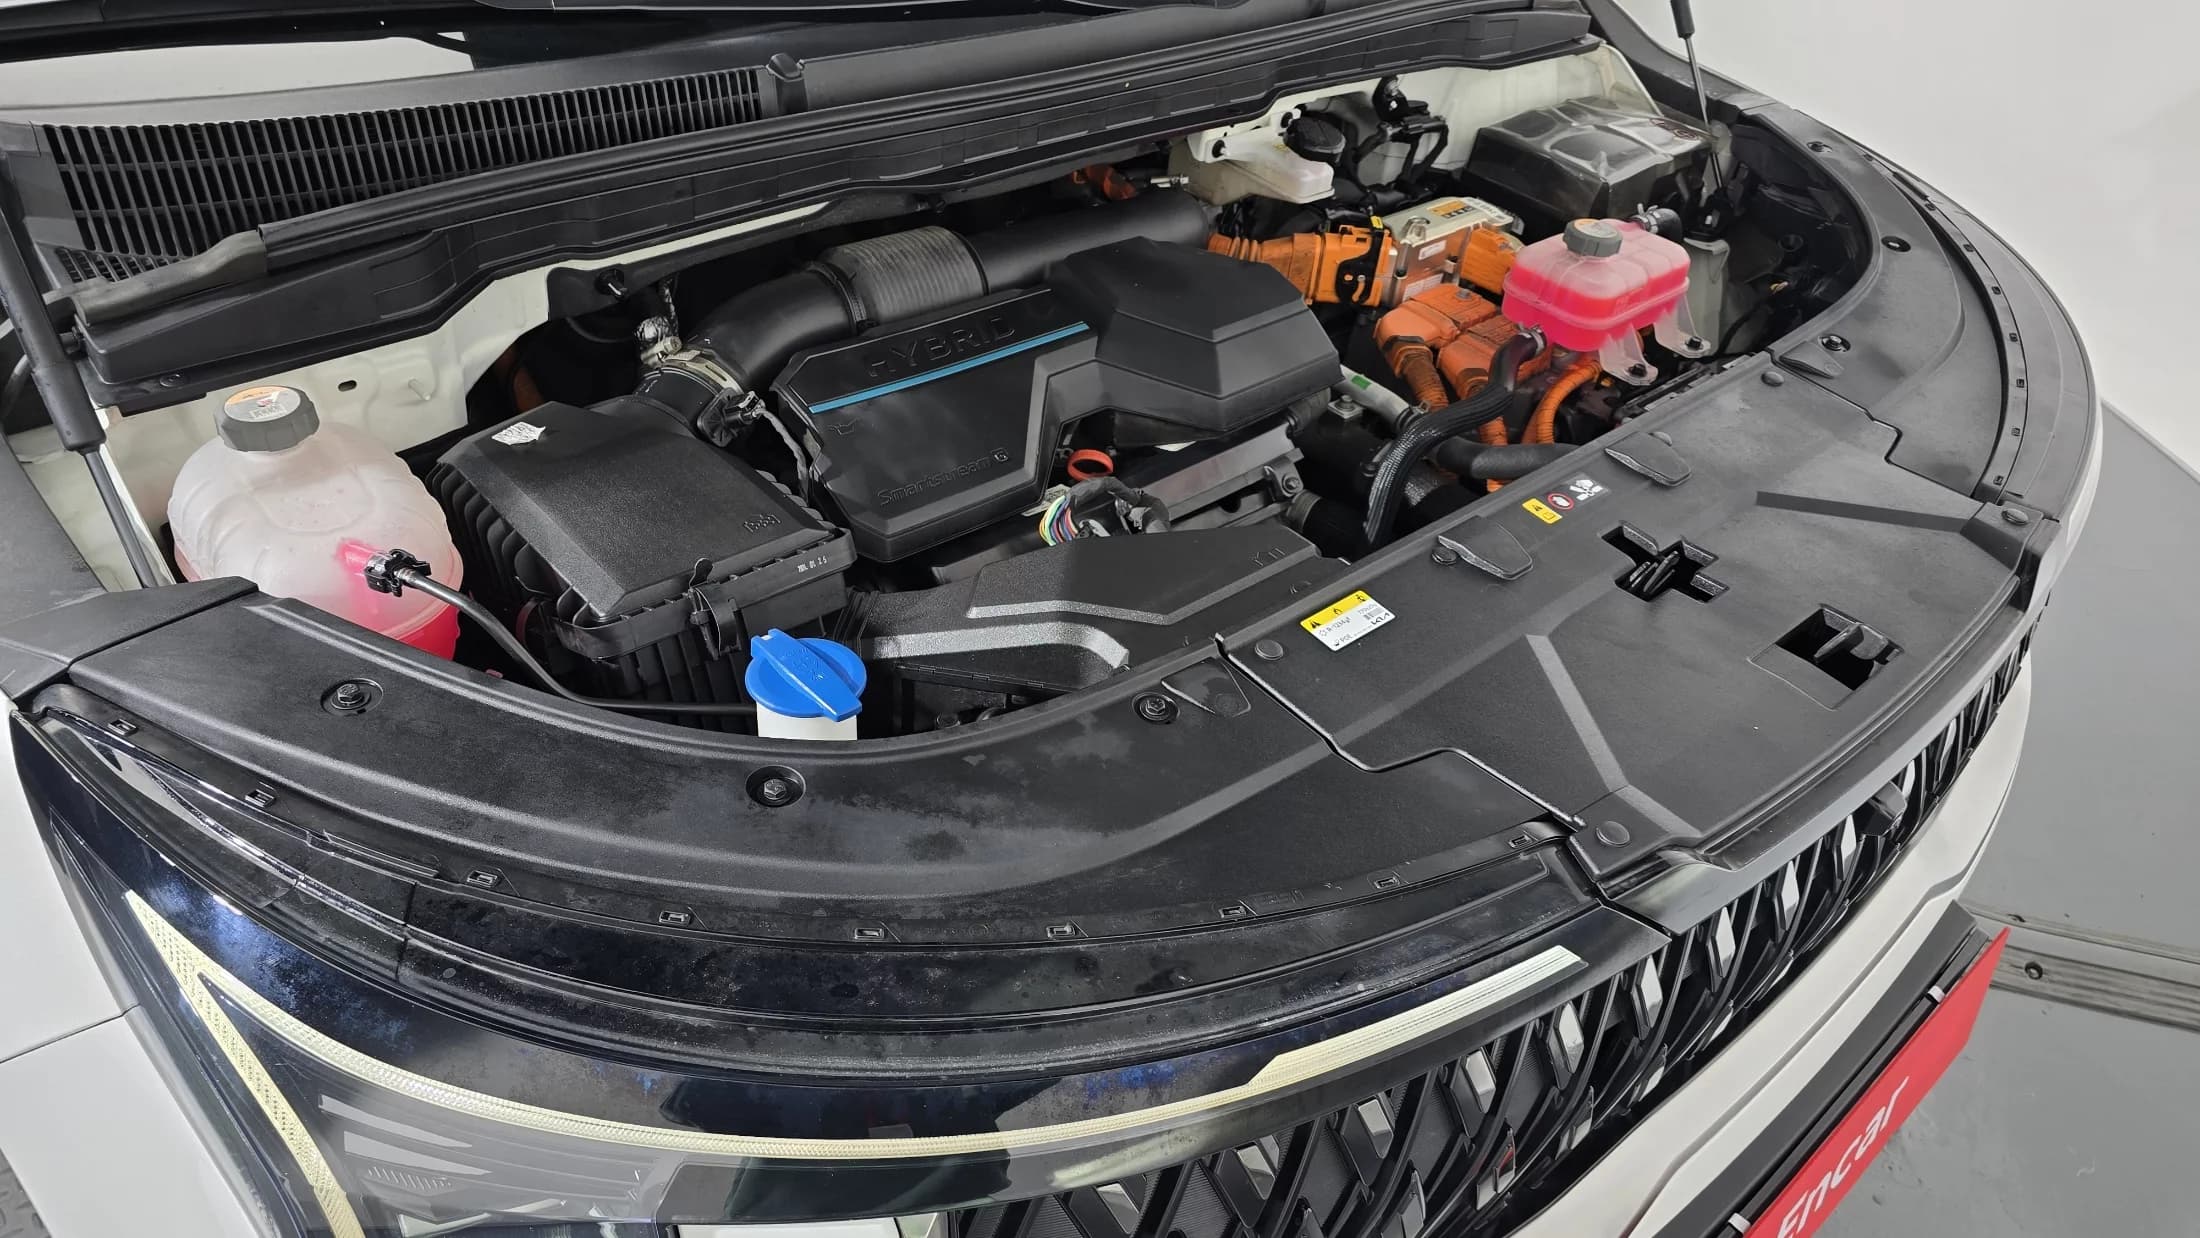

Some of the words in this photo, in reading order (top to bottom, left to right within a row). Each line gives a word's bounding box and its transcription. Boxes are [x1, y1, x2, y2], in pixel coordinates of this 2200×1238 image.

[867, 317, 1016, 378] HYBRID
[877, 456, 992, 507] Smartstream
[1777, 1075, 1910, 1238] Encar
